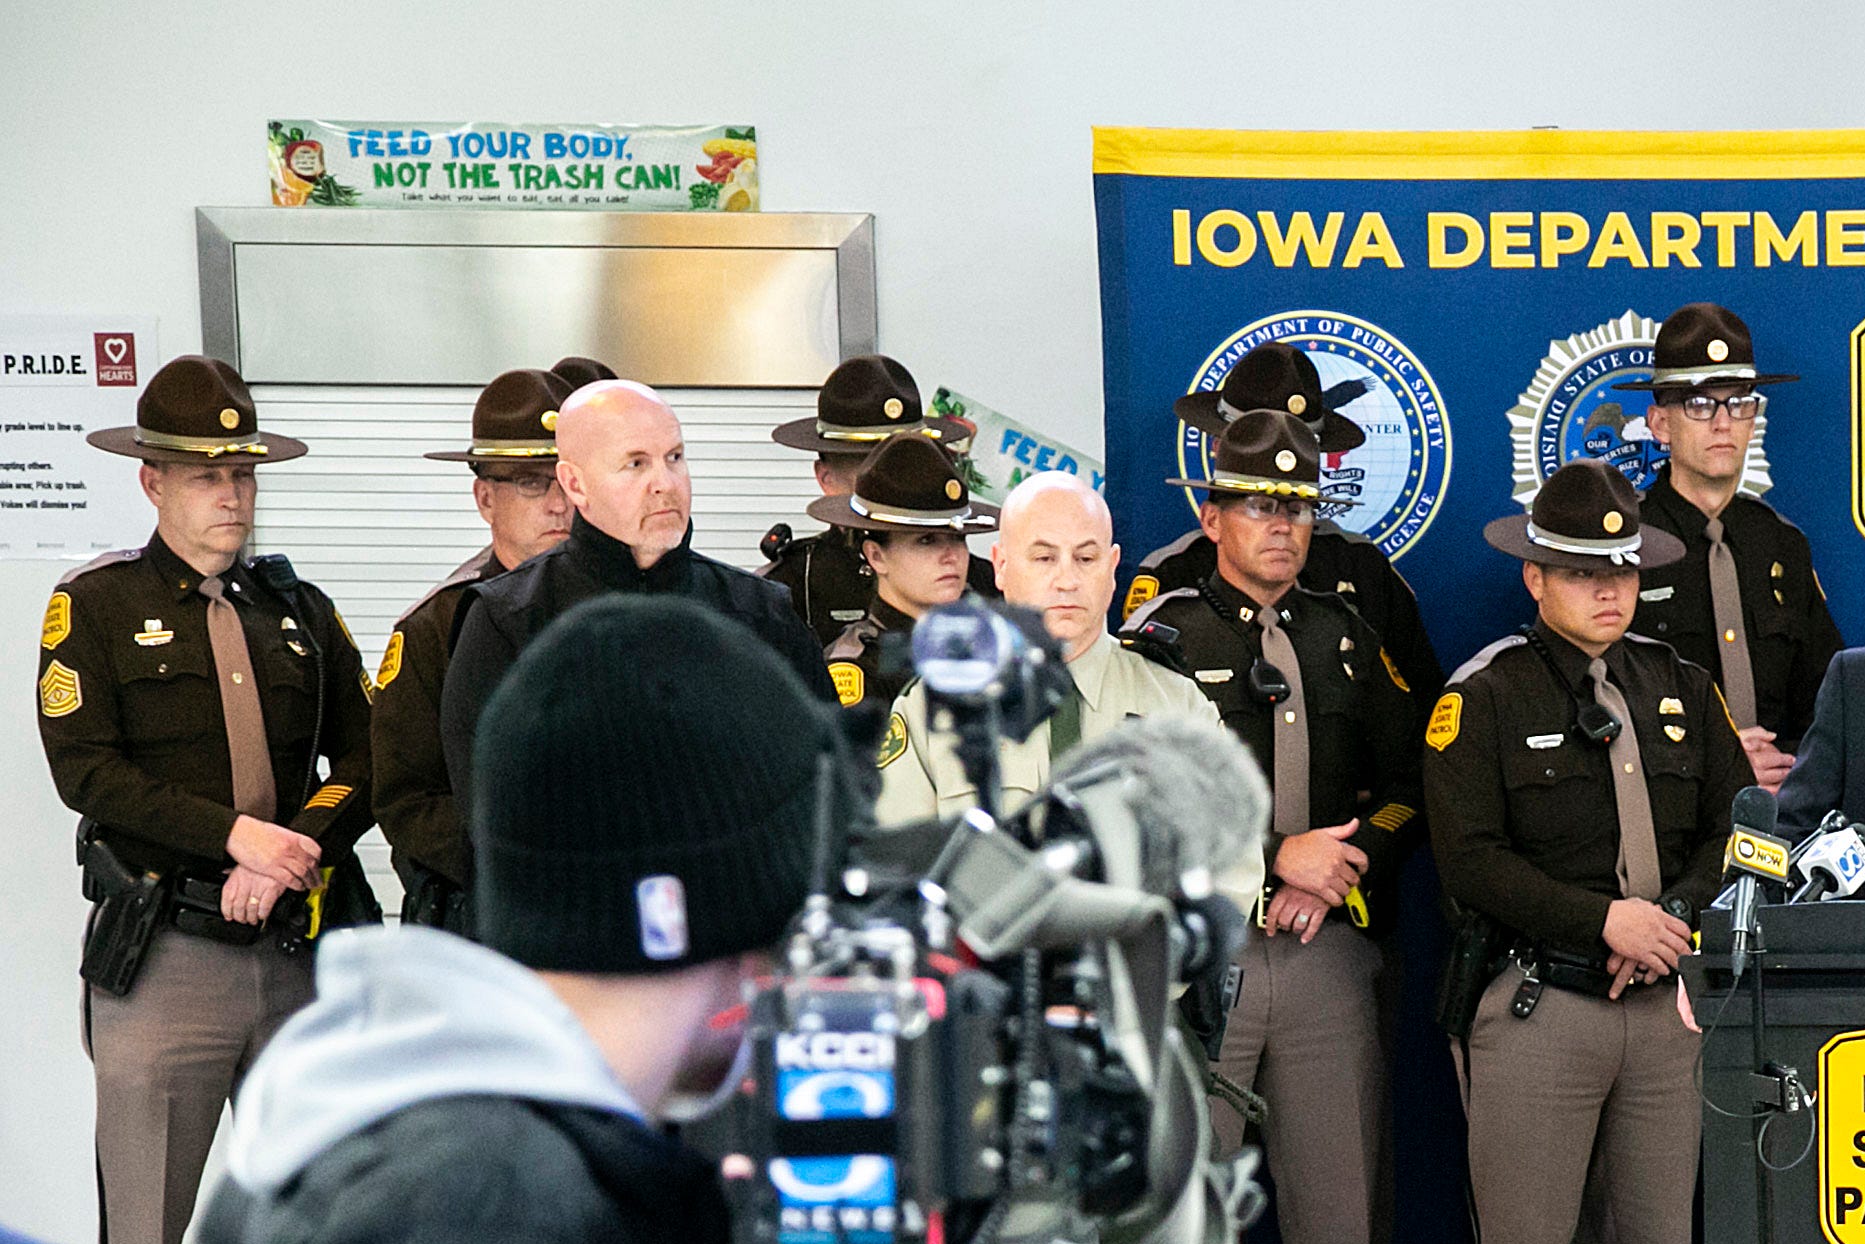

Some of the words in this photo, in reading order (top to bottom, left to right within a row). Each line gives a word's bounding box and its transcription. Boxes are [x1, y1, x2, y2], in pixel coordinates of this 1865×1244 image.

[347, 129, 432, 158] FEED
[446, 131, 532, 160] YOUR
[373, 161, 432, 189] NOT
[443, 162, 500, 189] THE
[508, 163, 605, 190] TRASH
[615, 164, 681, 191] CAN!
[429, 193, 452, 202] what
[457, 194, 474, 204] you
[507, 194, 518, 203] to
[584, 196, 600, 205] you
[1172, 209, 1404, 269] IOWA
[4, 354, 87, 375] P.R.I.D.E.
[99, 370, 135, 381] HEARTS
[1563, 352, 1624, 397] STATE
[1629, 350, 1656, 366] OF
[1200, 318, 1309, 393] DEPARTMENT
[1317, 319, 1346, 336] OF
[1350, 326, 1414, 376] PUBLIC
[1410, 377, 1445, 450] SAFETY
[1361, 423, 1403, 435] NTER
[1541, 398, 1567, 478] DIVISIO
[1586, 440, 1609, 450] OUR
[1328, 469, 1363, 479] RIGHTS
[1618, 460, 1640, 472] RIZE
[1337, 484, 1359, 495] WILL
[1382, 492, 1435, 555] IGENCE
[776, 1030, 894, 1071] KCCI
